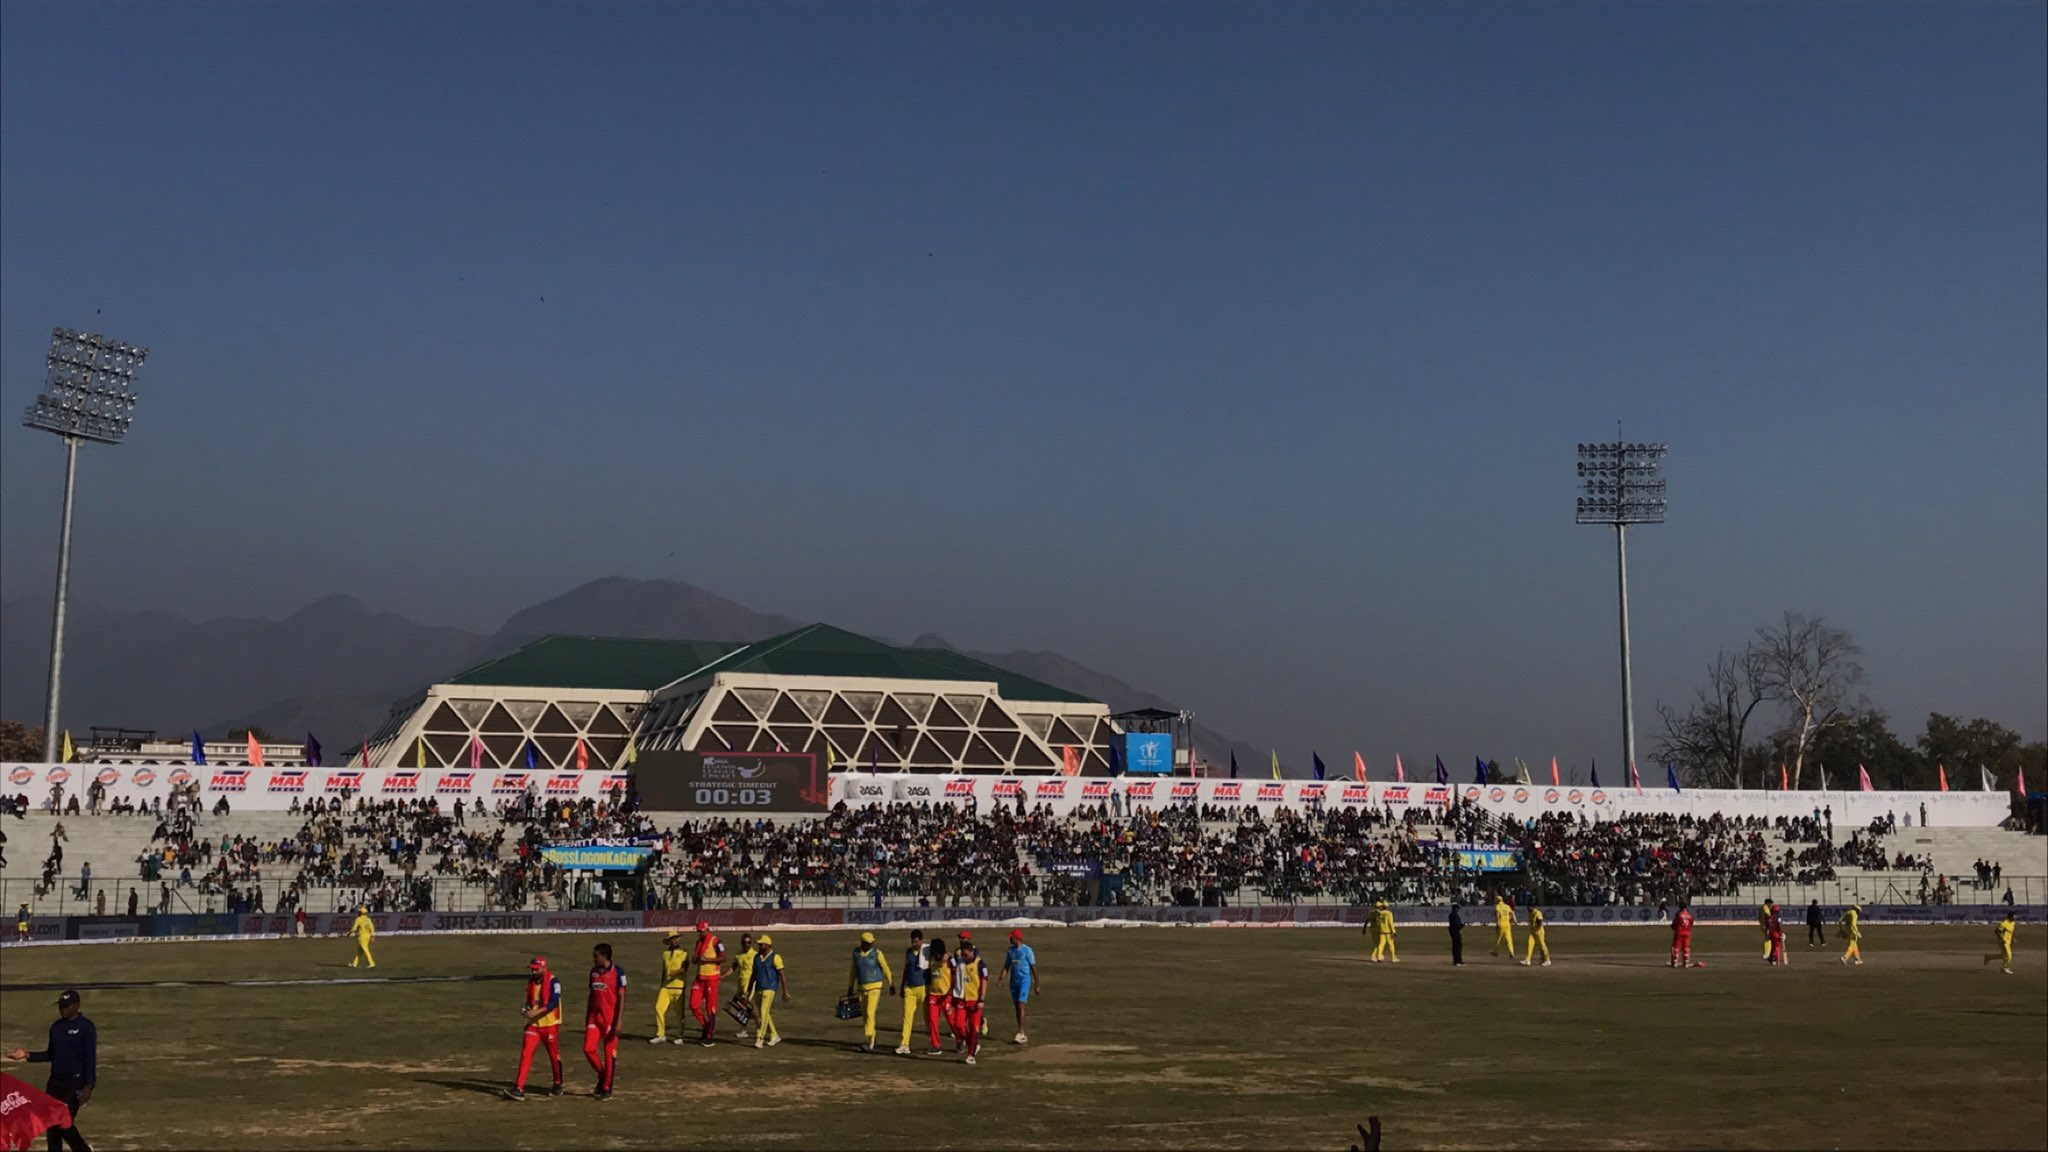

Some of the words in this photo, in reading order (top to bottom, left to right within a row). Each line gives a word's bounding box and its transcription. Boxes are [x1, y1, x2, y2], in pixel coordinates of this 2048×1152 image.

[211, 773, 250, 786] MAX
[269, 774, 308, 787] MAX
[326, 775, 364, 787] MAX
[383, 776, 420, 788] MAX
[437, 776, 475, 788] MAX
[546, 777, 583, 789] MAX
[944, 781, 976, 792] MAX
[992, 783, 1022, 794] MAX
[1036, 783, 1067, 794] MAX
[1081, 784, 1111, 795] MAX
[1171, 785, 1200, 796] MAX
[1213, 785, 1242, 796] MAX
[1257, 786, 1285, 796] MAX
[695, 789, 772, 805] 00:03
[1343, 788, 1370, 798] MAX
[1383, 789, 1410, 799] MAX
[1424, 790, 1450, 800] MAX
[596, 838, 630, 847] BLOCK
[632, 837, 639, 846] 3
[1474, 843, 1500, 851] BLOCK
[847, 910, 890, 921] 1XBAT
[894, 910, 935, 921] 1XBAT
[942, 909, 984, 920] 1XBAT
[432, 914, 477, 929] अमर
[479, 914, 533, 929] उजाला
[546, 914, 635, 928] amarujala.com
